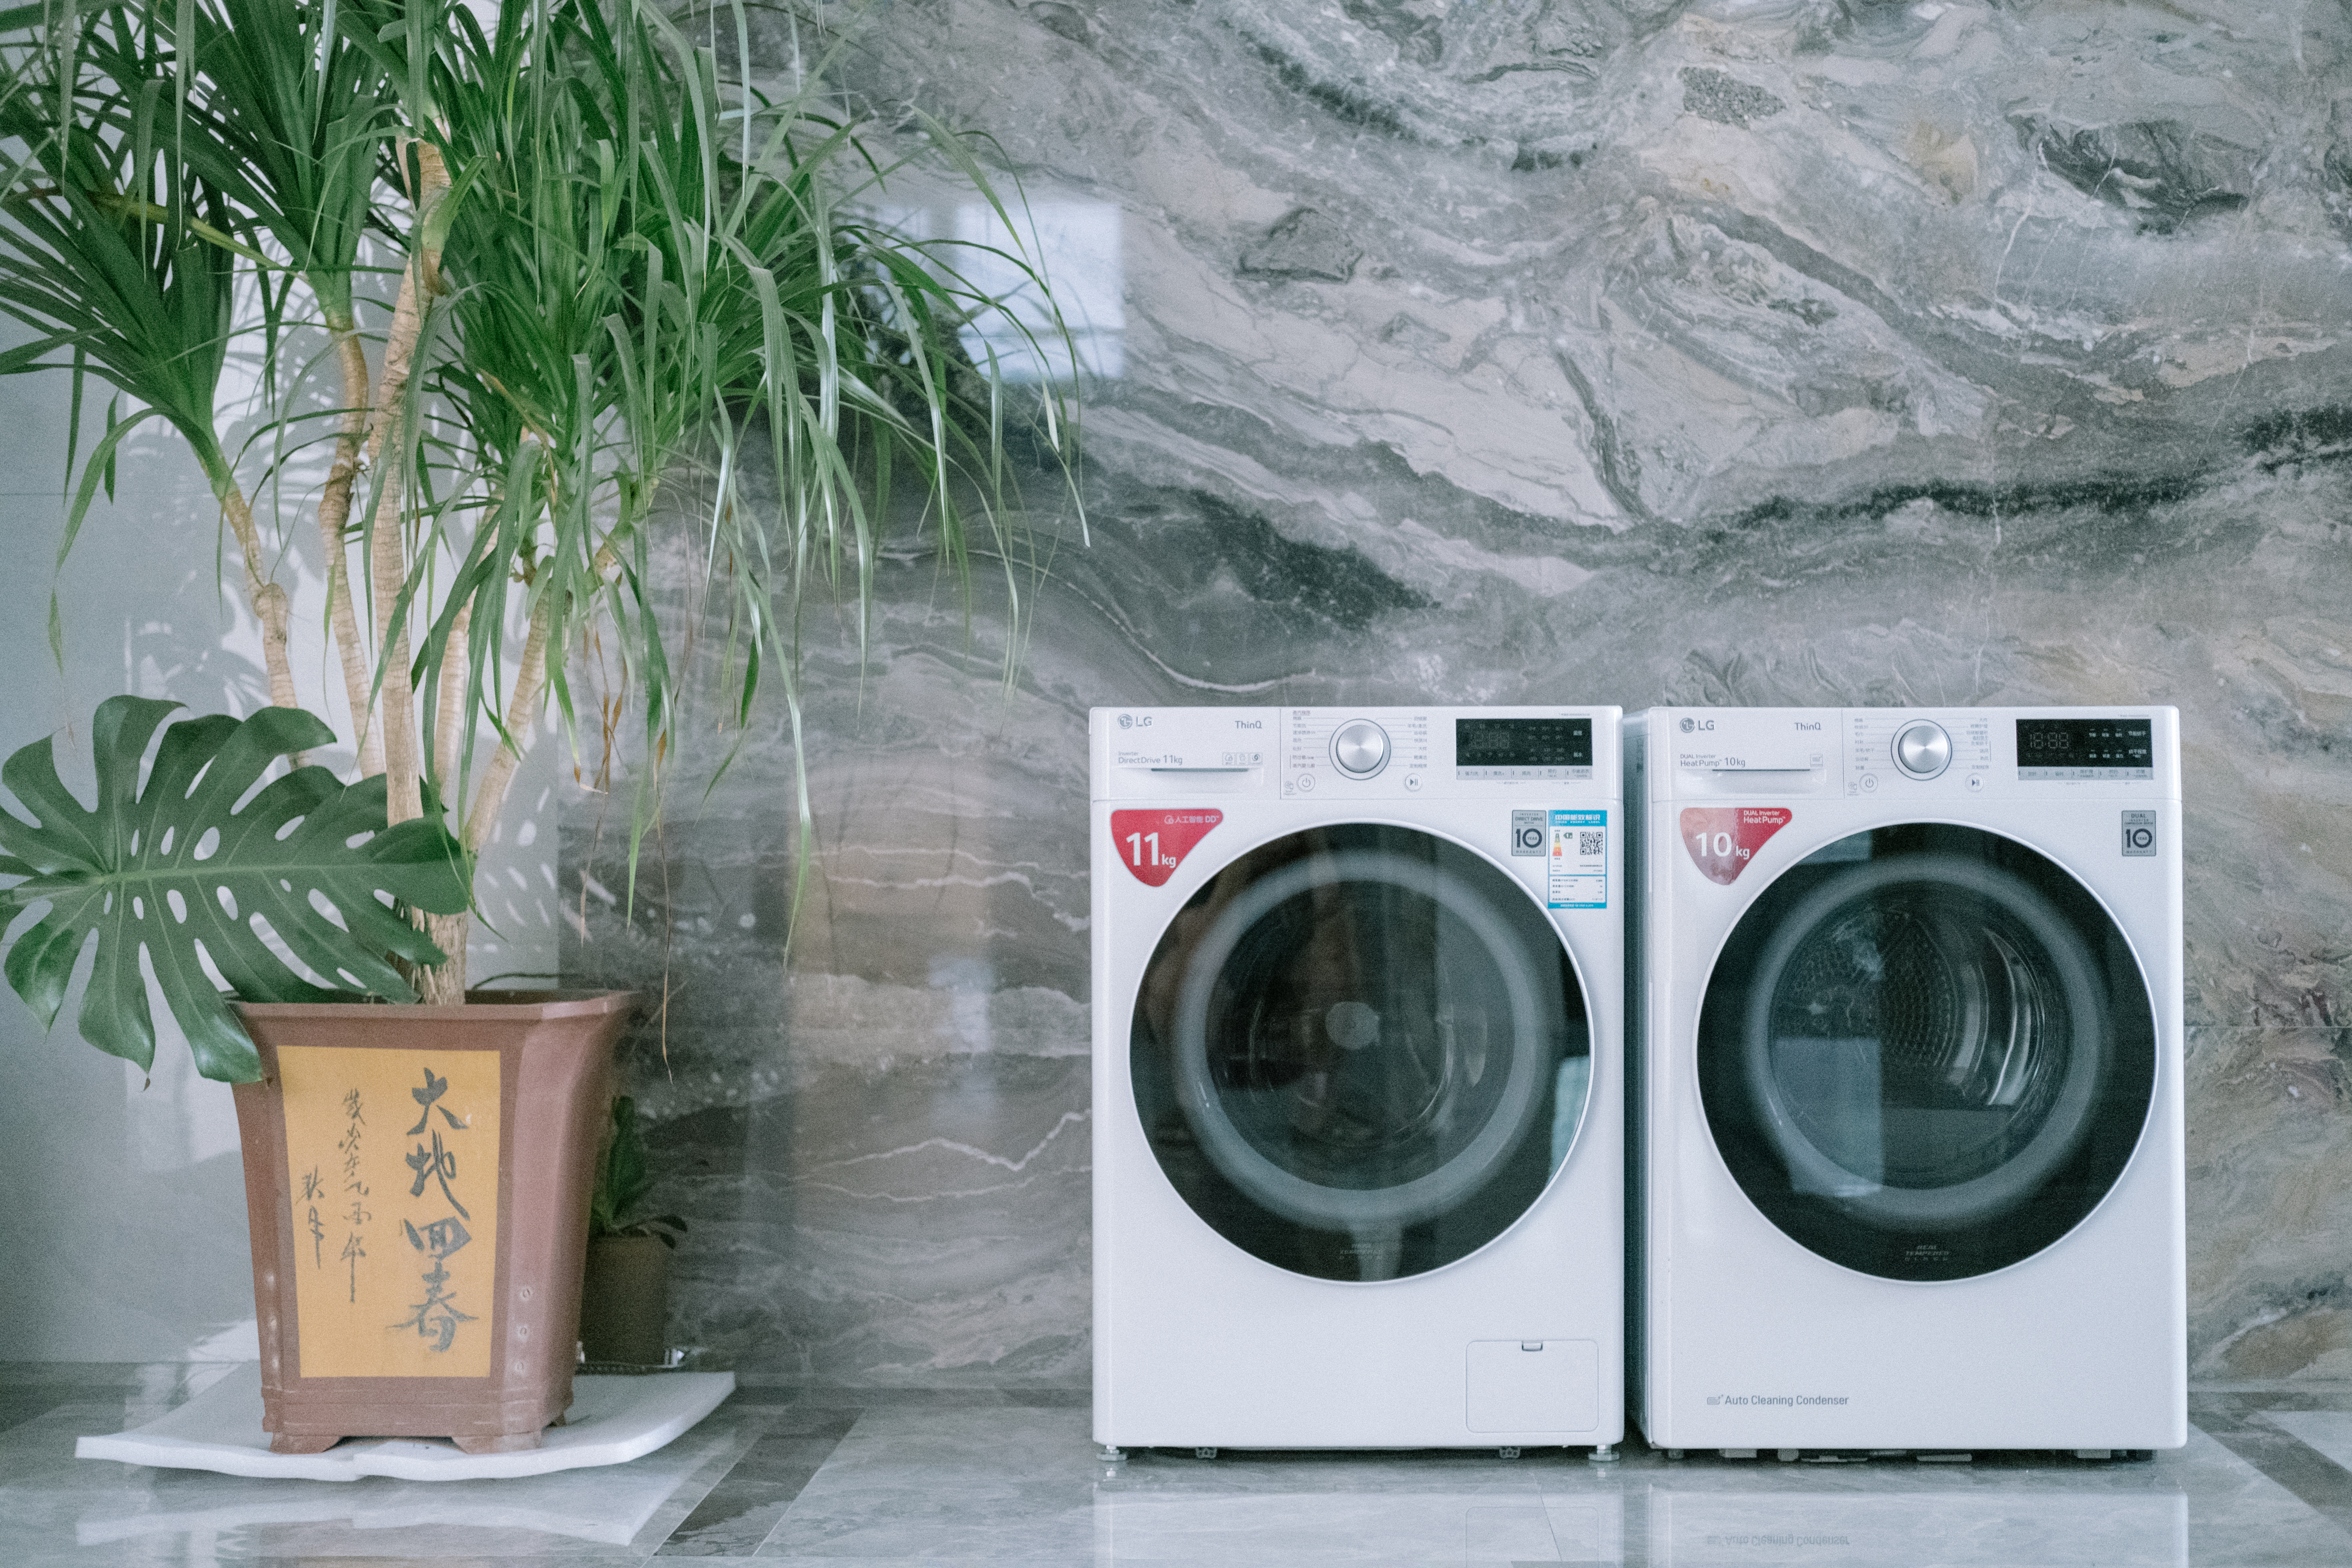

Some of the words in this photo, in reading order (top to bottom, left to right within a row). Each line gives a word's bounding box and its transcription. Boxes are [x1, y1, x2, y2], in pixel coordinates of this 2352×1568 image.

[1136, 716, 1153, 727] LG
[1235, 720, 1263, 729] ThinQ
[1698, 720, 1715, 730] LG
[1794, 722, 1821, 730] ThinQ
[1516, 828, 1542, 848] 10
[2126, 828, 2153, 848] 10
[1725, 1395, 1749, 1405] Auto
[1751, 1395, 1793, 1407] Cleaning
[1796, 1395, 1849, 1405] Condenser
